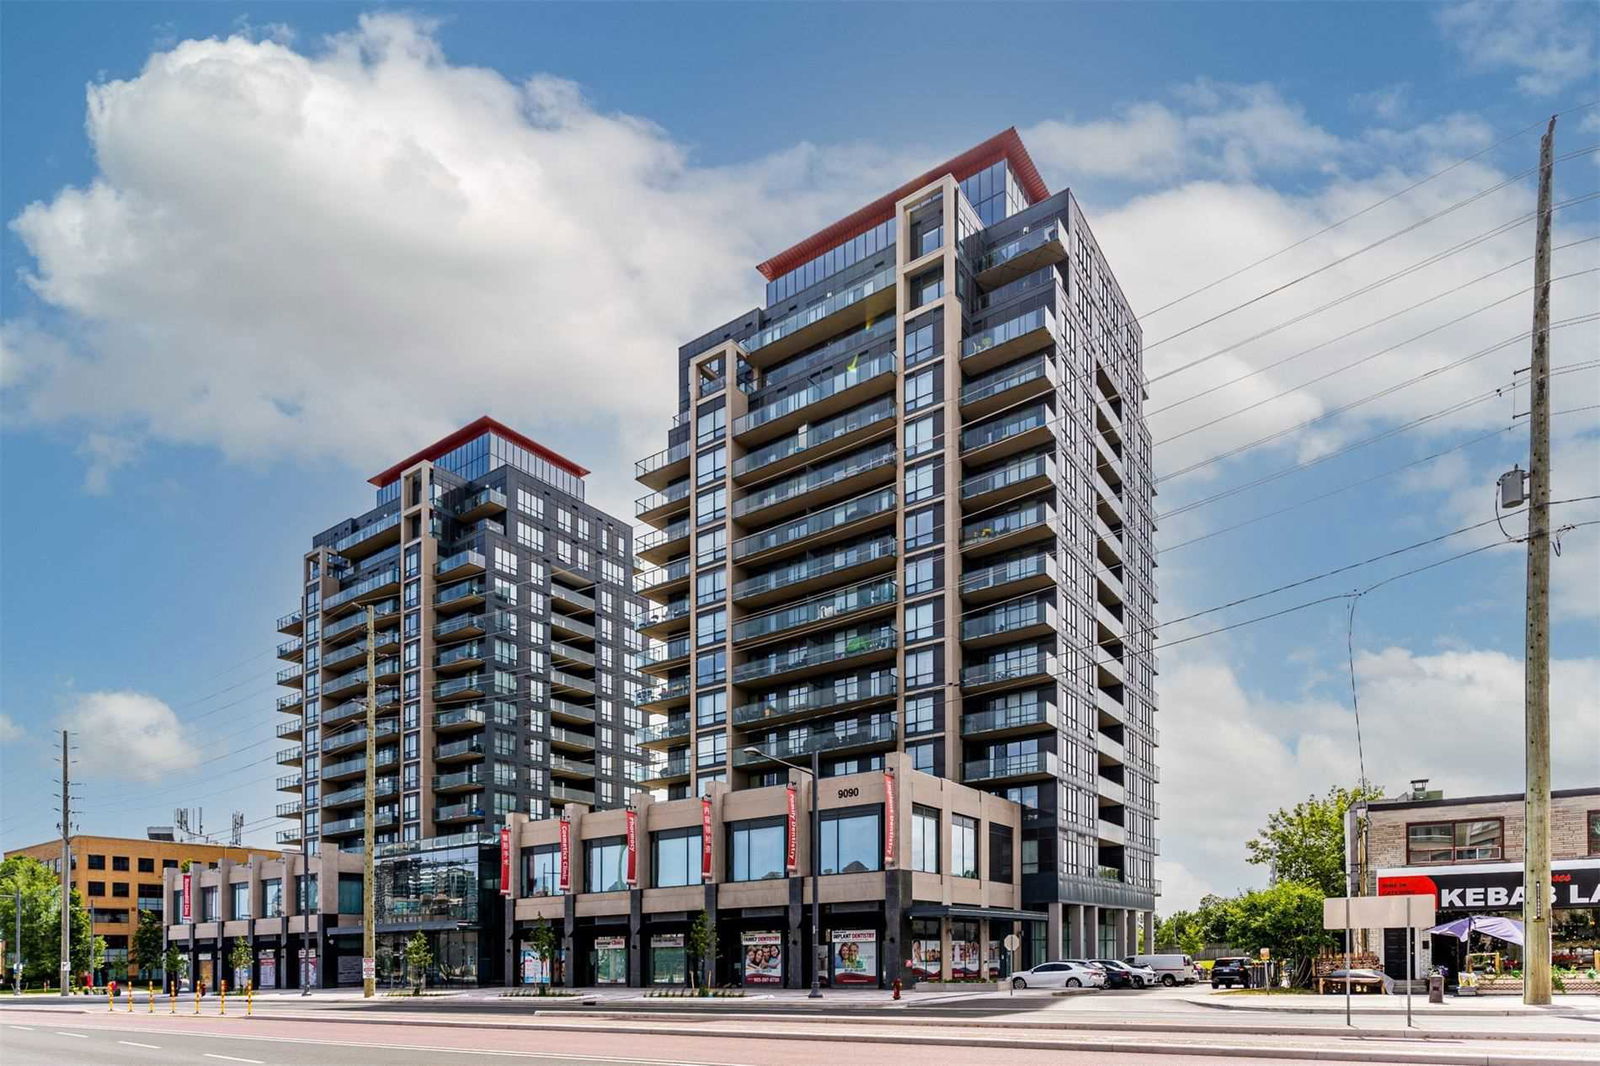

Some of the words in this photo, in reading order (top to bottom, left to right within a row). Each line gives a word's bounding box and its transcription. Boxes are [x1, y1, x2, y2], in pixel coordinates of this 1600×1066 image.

[838, 787, 859, 799] 9090
[628, 816, 636, 852] Pharmacy
[1441, 886, 1557, 907] KEBA
